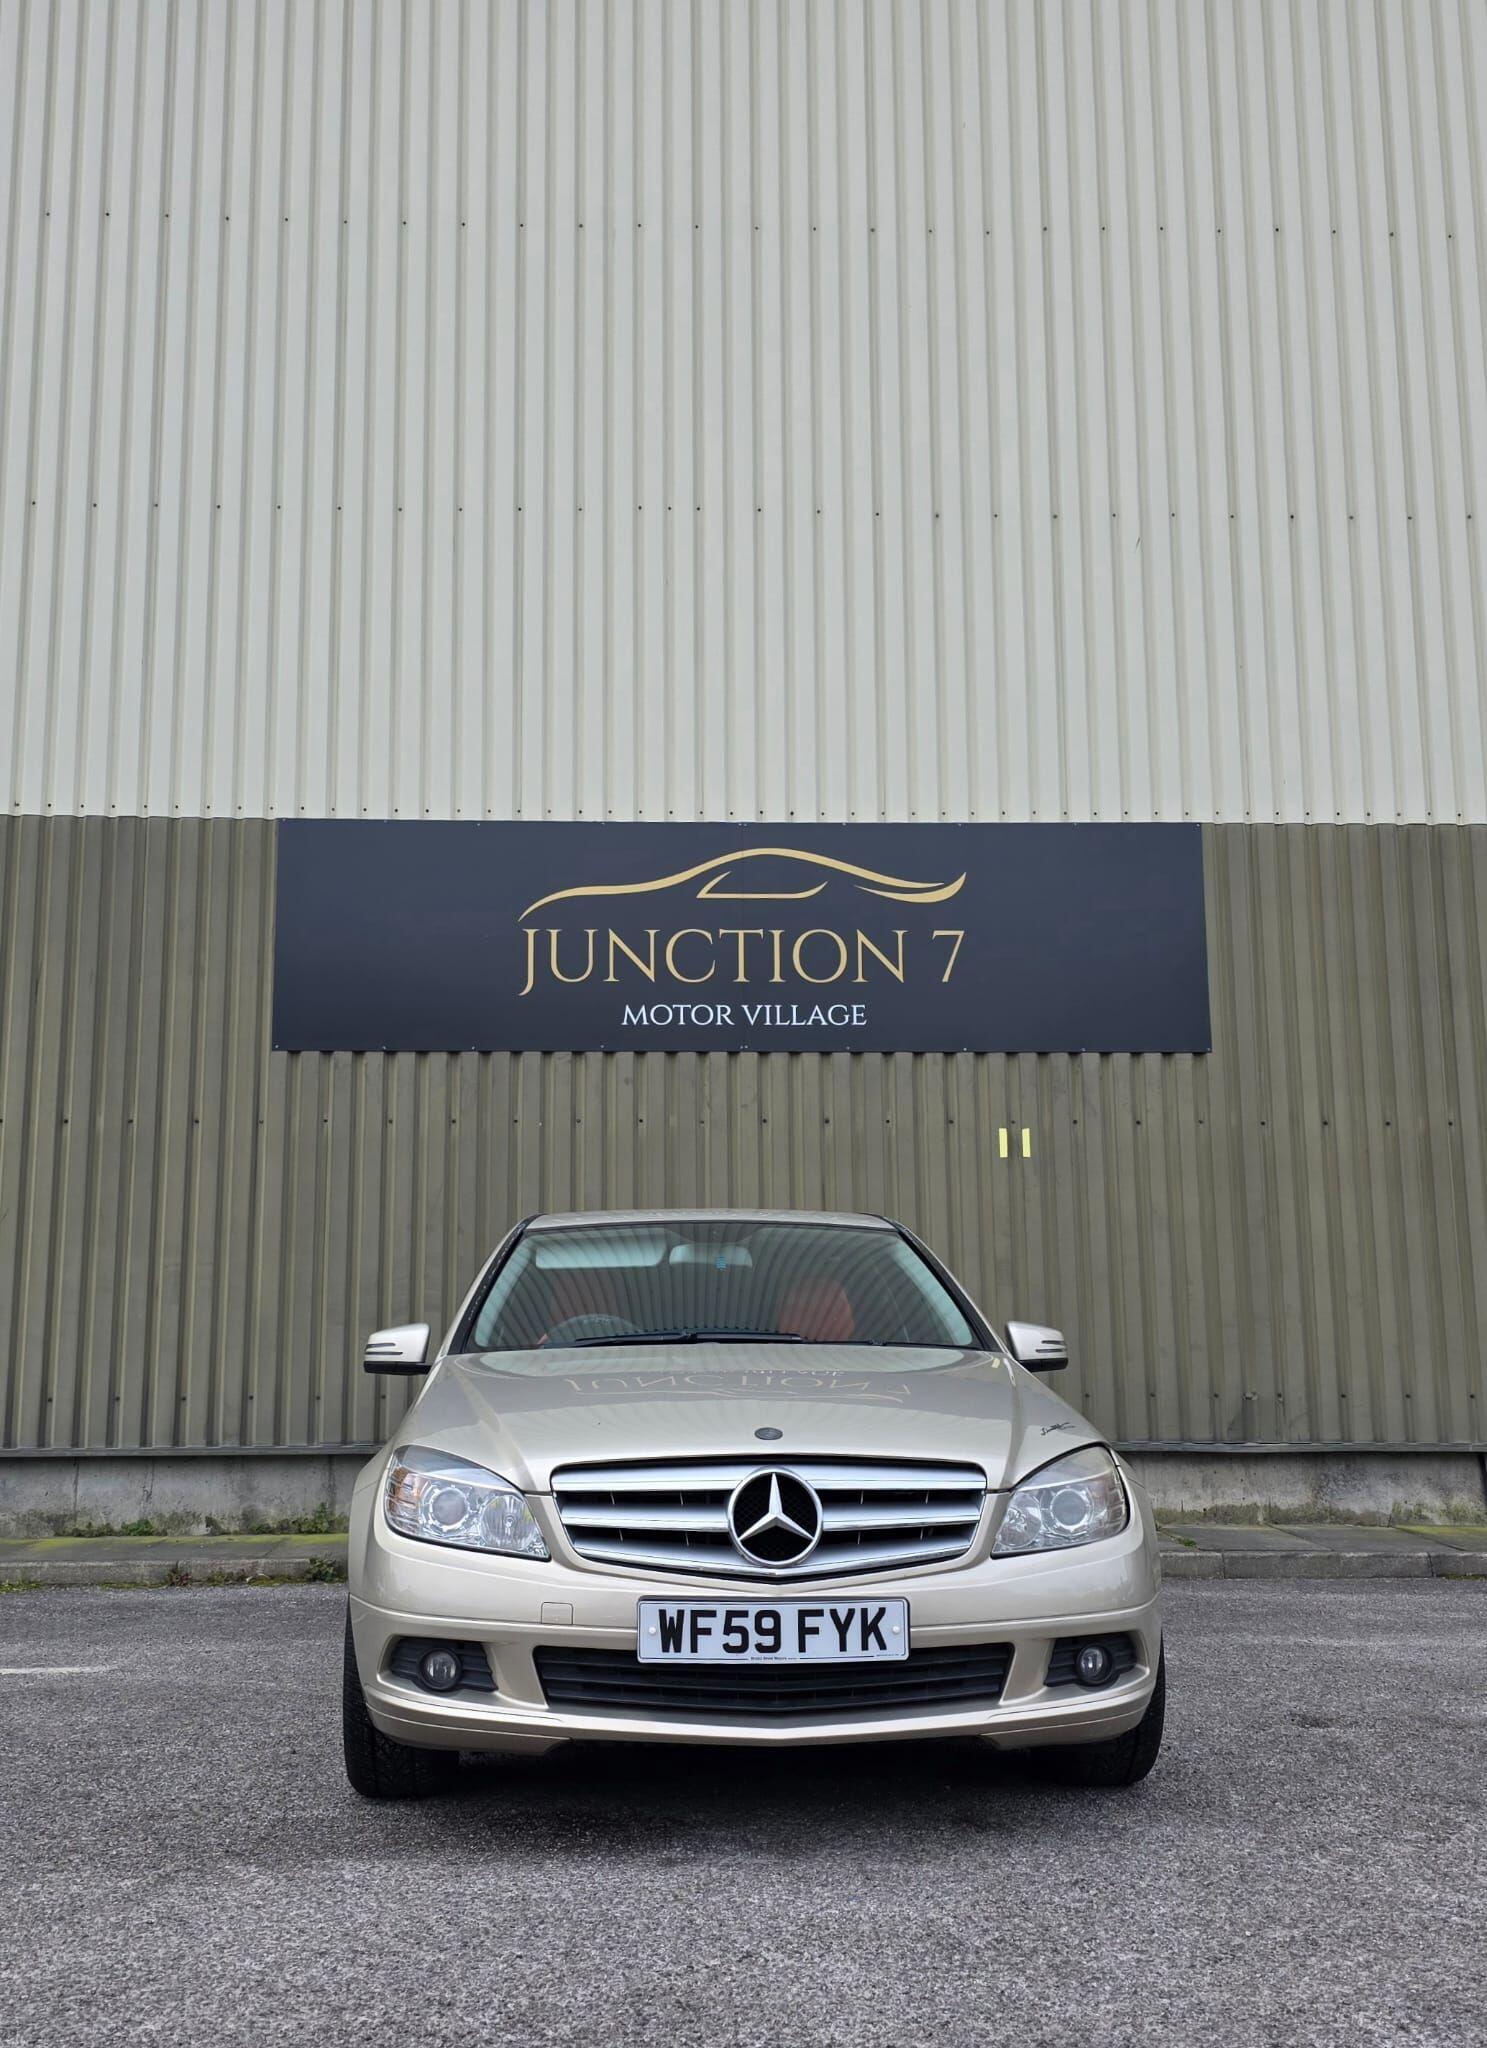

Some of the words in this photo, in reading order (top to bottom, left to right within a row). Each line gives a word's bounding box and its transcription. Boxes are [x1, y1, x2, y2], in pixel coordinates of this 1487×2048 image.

[518, 928, 908, 996] JUNCTION
[932, 929, 966, 983] 7
[621, 1003, 735, 1026] MOTOR
[741, 1003, 868, 1026] VILLAGE
[658, 1608, 782, 1654] WF59
[797, 1606, 888, 1654] FYK
